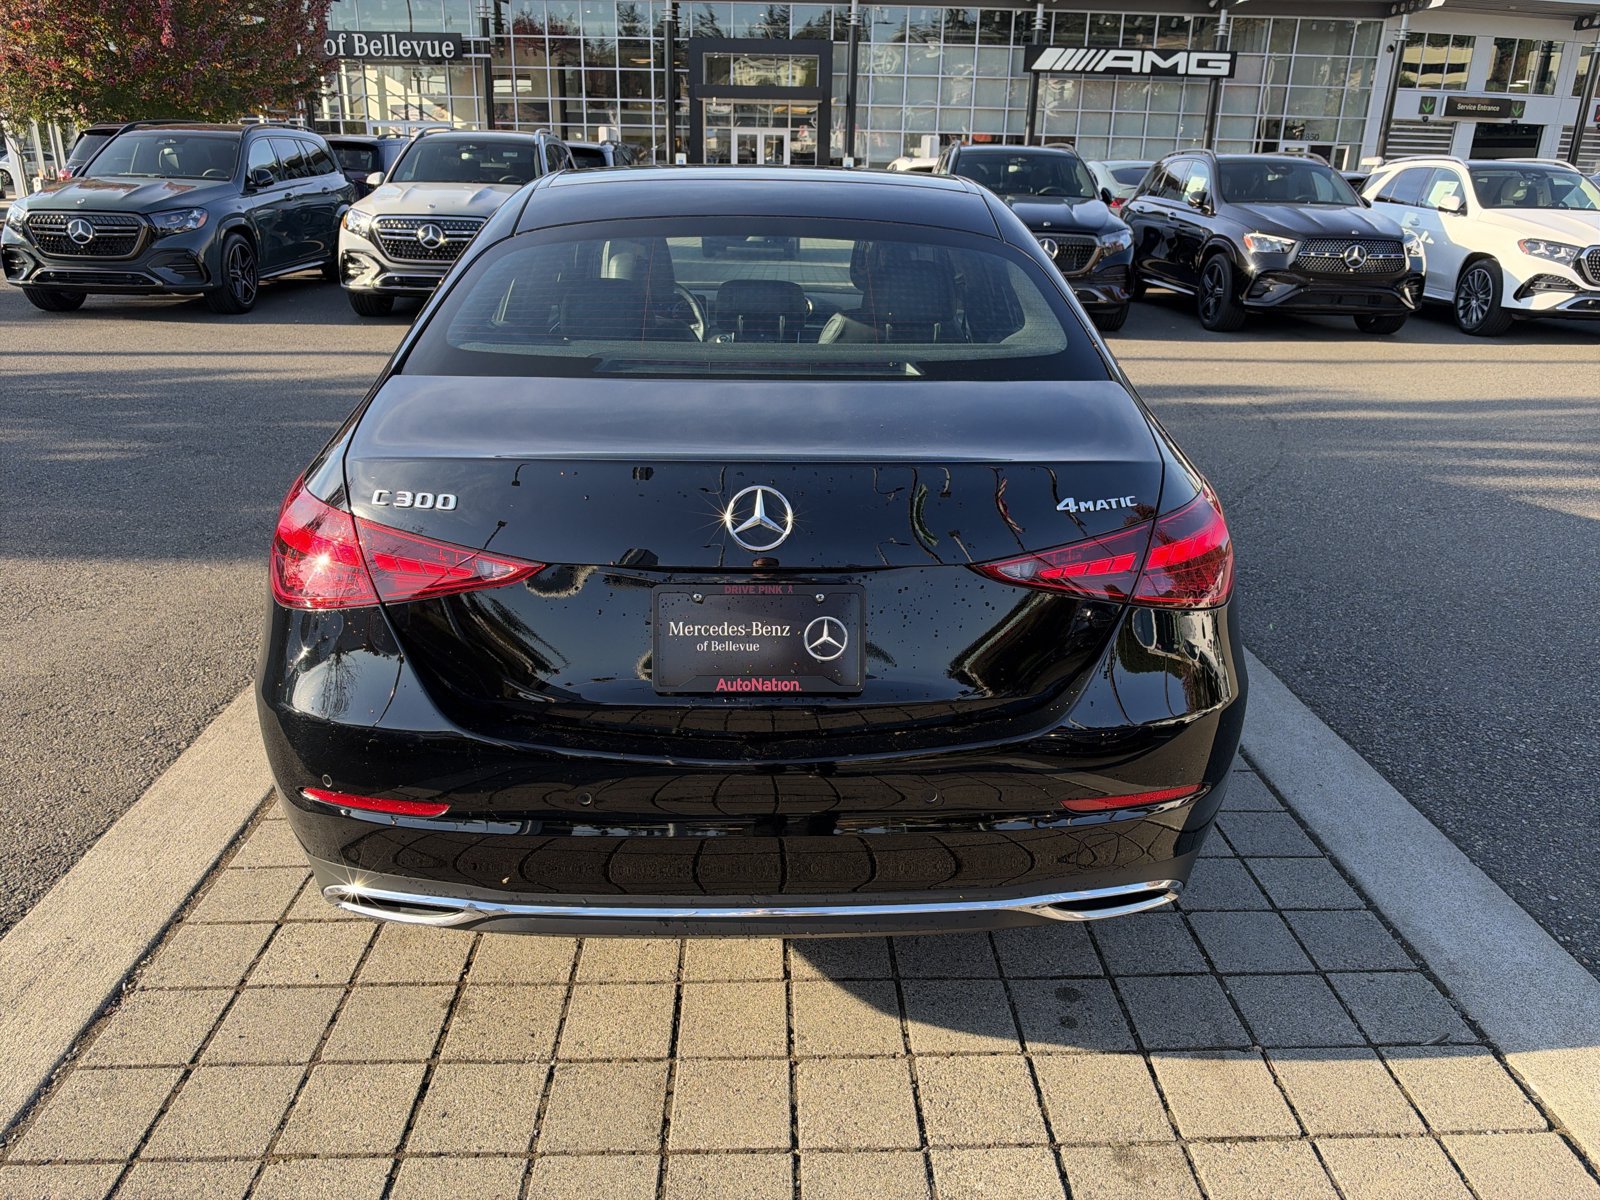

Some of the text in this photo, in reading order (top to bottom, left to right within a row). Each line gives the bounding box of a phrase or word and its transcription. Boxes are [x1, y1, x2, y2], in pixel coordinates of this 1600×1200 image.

[323, 33, 347, 56] of
[351, 33, 456, 58] Bellevue
[1093, 49, 1232, 76] AMG
[1456, 103, 1501, 112] Service Entrance
[371, 489, 457, 511] C 300
[1056, 495, 1138, 513] 4MATIC
[724, 584, 783, 594] DRIVE PINK
[668, 621, 791, 637] Mercedes-Benz
[696, 640, 760, 652] of Bellevue
